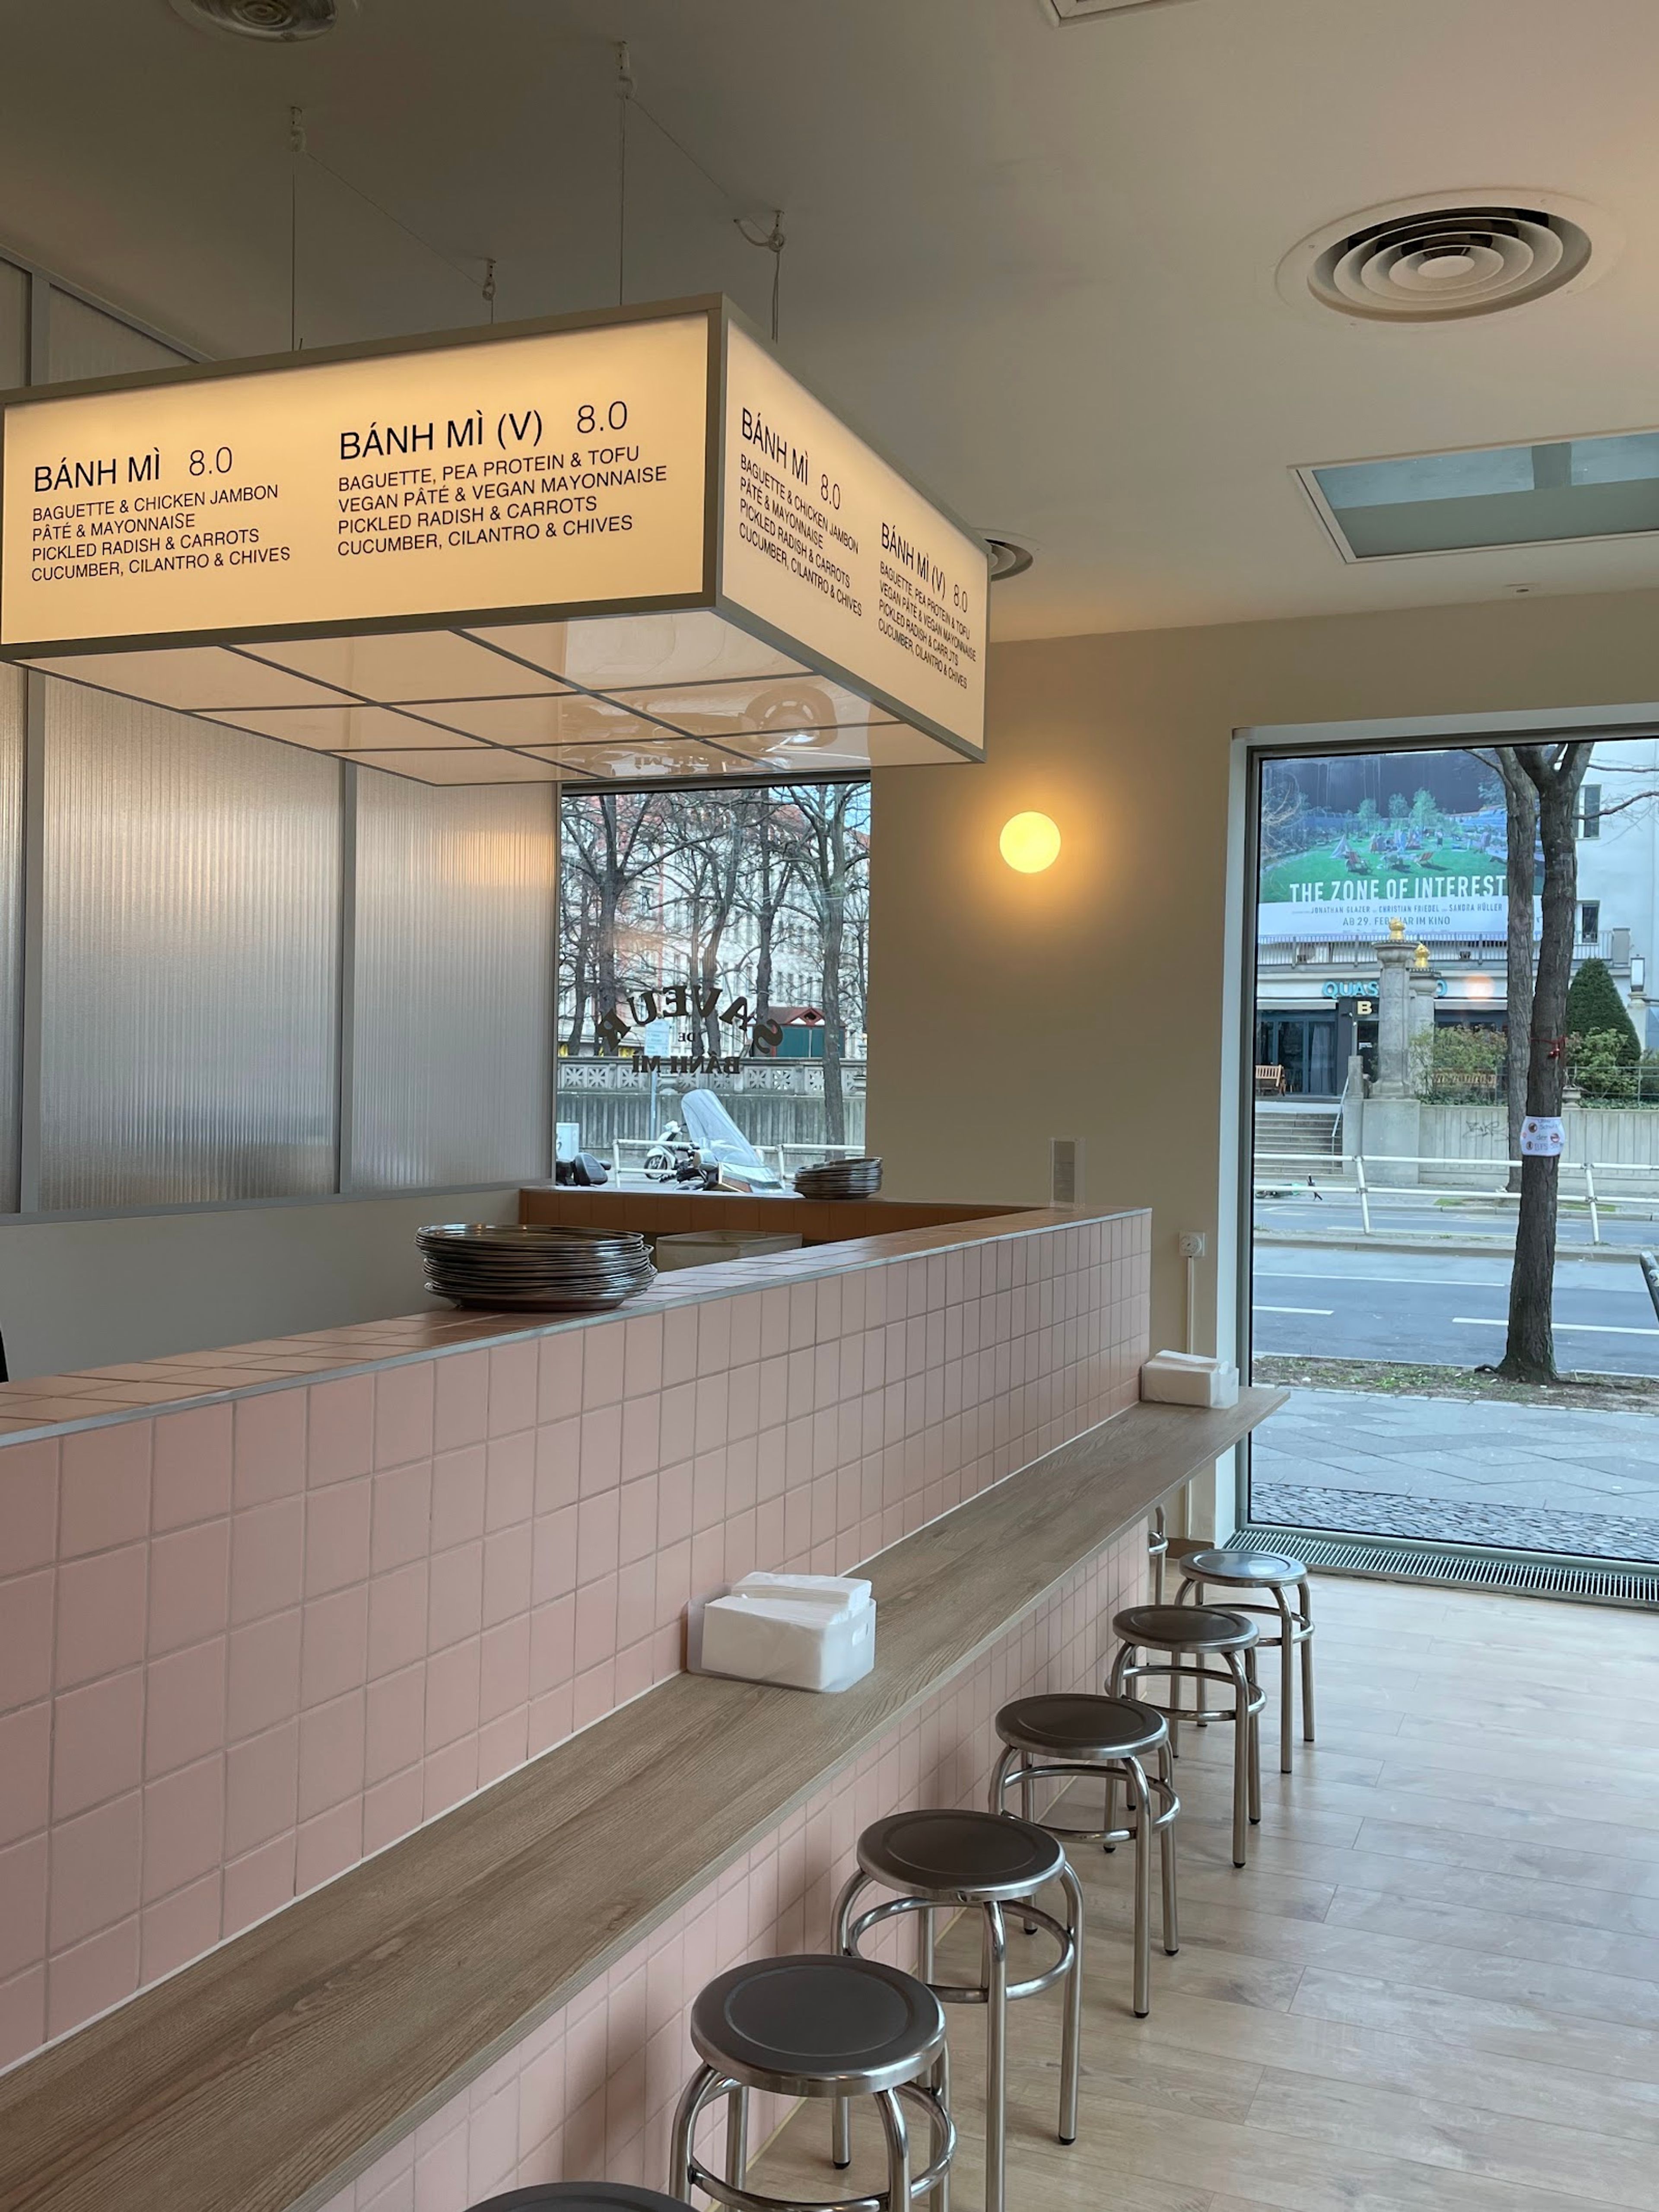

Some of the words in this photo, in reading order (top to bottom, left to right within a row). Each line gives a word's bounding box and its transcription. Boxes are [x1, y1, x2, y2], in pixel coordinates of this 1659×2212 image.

[340, 421, 433, 460] BÁNH
[447, 409, 483, 449] MÌ
[497, 409, 542, 450] (V)
[576, 401, 627, 433] 8.0
[34, 457, 116, 492] BÁNH
[128, 446, 159, 483] MÌ
[189, 446, 232, 476] 8.0
[339, 468, 436, 492] BAGUETTE,
[442, 463, 478, 481] PEA
[483, 454, 564, 477] PROTEIN
[570, 452, 582, 469] &
[587, 445, 639, 465] TOFU
[742, 407, 787, 469] BÁNH
[791, 448, 808, 486] MÌ
[820, 474, 840, 510] 8.0
[33, 501, 114, 521] BAGUETTE
[120, 500, 129, 513] &
[134, 492, 205, 511] CHICKEN
[210, 484, 277, 504] JAMBON
[338, 493, 398, 512] VEGAN
[404, 484, 449, 507] PÂTÉ
[454, 487, 466, 502] &
[472, 479, 534, 500] VEGAN
[541, 465, 667, 493] MAYONNAISE
[740, 453, 785, 500] BAGUETTE
[787, 490, 792, 506] &
[794, 495, 828, 532] CHICKEN
[829, 523, 858, 554] JAMBON
[32, 523, 71, 541] PÂTÉ
[76, 524, 86, 537] &
[90, 513, 195, 537] MAYONNAISE
[338, 514, 411, 535] PICKLED
[417, 507, 483, 528] RADISH
[489, 506, 501, 520] &
[507, 496, 597, 519] CARROTS
[740, 476, 763, 506] PÂTÉ
[764, 494, 770, 511] &
[772, 499, 823, 549] MAYONNAISE
[32, 543, 96, 562] PICKLED
[102, 538, 160, 555] RADISH
[165, 536, 175, 550] &
[180, 528, 259, 549] CARROTS
[337, 533, 442, 556] CUCUMBER,
[448, 523, 540, 546] CILANTRO
[545, 522, 557, 538] &
[563, 515, 632, 536] CHIVES
[740, 497, 776, 536] PICKLED
[777, 525, 807, 559] RADISH
[808, 548, 814, 564] &
[815, 553, 850, 589] CARROTS
[32, 561, 123, 581] CUCUMBER,
[129, 553, 209, 573] CILANTRO
[213, 552, 223, 567] &
[229, 546, 290, 565] CHIVES
[739, 522, 789, 570] CUCUMBER,
[791, 557, 829, 594] CILANTRO
[830, 584, 835, 599] &
[836, 589, 862, 617] CHIVES
[881, 522, 914, 570] BÁNH
[916, 551, 928, 582] MÌ
[953, 584, 968, 613] 8.0
[879, 579, 901, 606] VEGAN
[902, 596, 917, 619] PÂTÉ
[918, 609, 922, 623] &
[923, 612, 942, 637] VEGAN
[943, 627, 976, 662] MAYONNAISE
[879, 598, 905, 627] PICKLED
[906, 618, 927, 644] RADISH
[928, 635, 932, 647] &
[914, 588, 926, 607] PEA
[927, 597, 950, 625] PROTEIN
[951, 617, 955, 629] &
[915, 644, 943, 672] CILANTRO
[943, 664, 947, 676] &
[947, 667, 967, 689] CHIVES
[1290, 882, 1324, 903] THE
[1331, 879, 1379, 901] ZONE
[1386, 878, 1408, 899] OF
[1415, 875, 1506, 899] INTEREST
[1379, 905, 1411, 913] CHRISTIAN
[1414, 904, 1439, 912] FRIEDEL
[1477, 902, 1502, 911] HÜLLER
[1343, 917, 1355, 926] AB
[1357, 917, 1372, 926] 29.
[1374, 916, 1414, 926] FEBAR
[1416, 917, 1426, 925] IM
[1428, 916, 1450, 925] KINO
[1357, 1001, 1373, 1015] B
